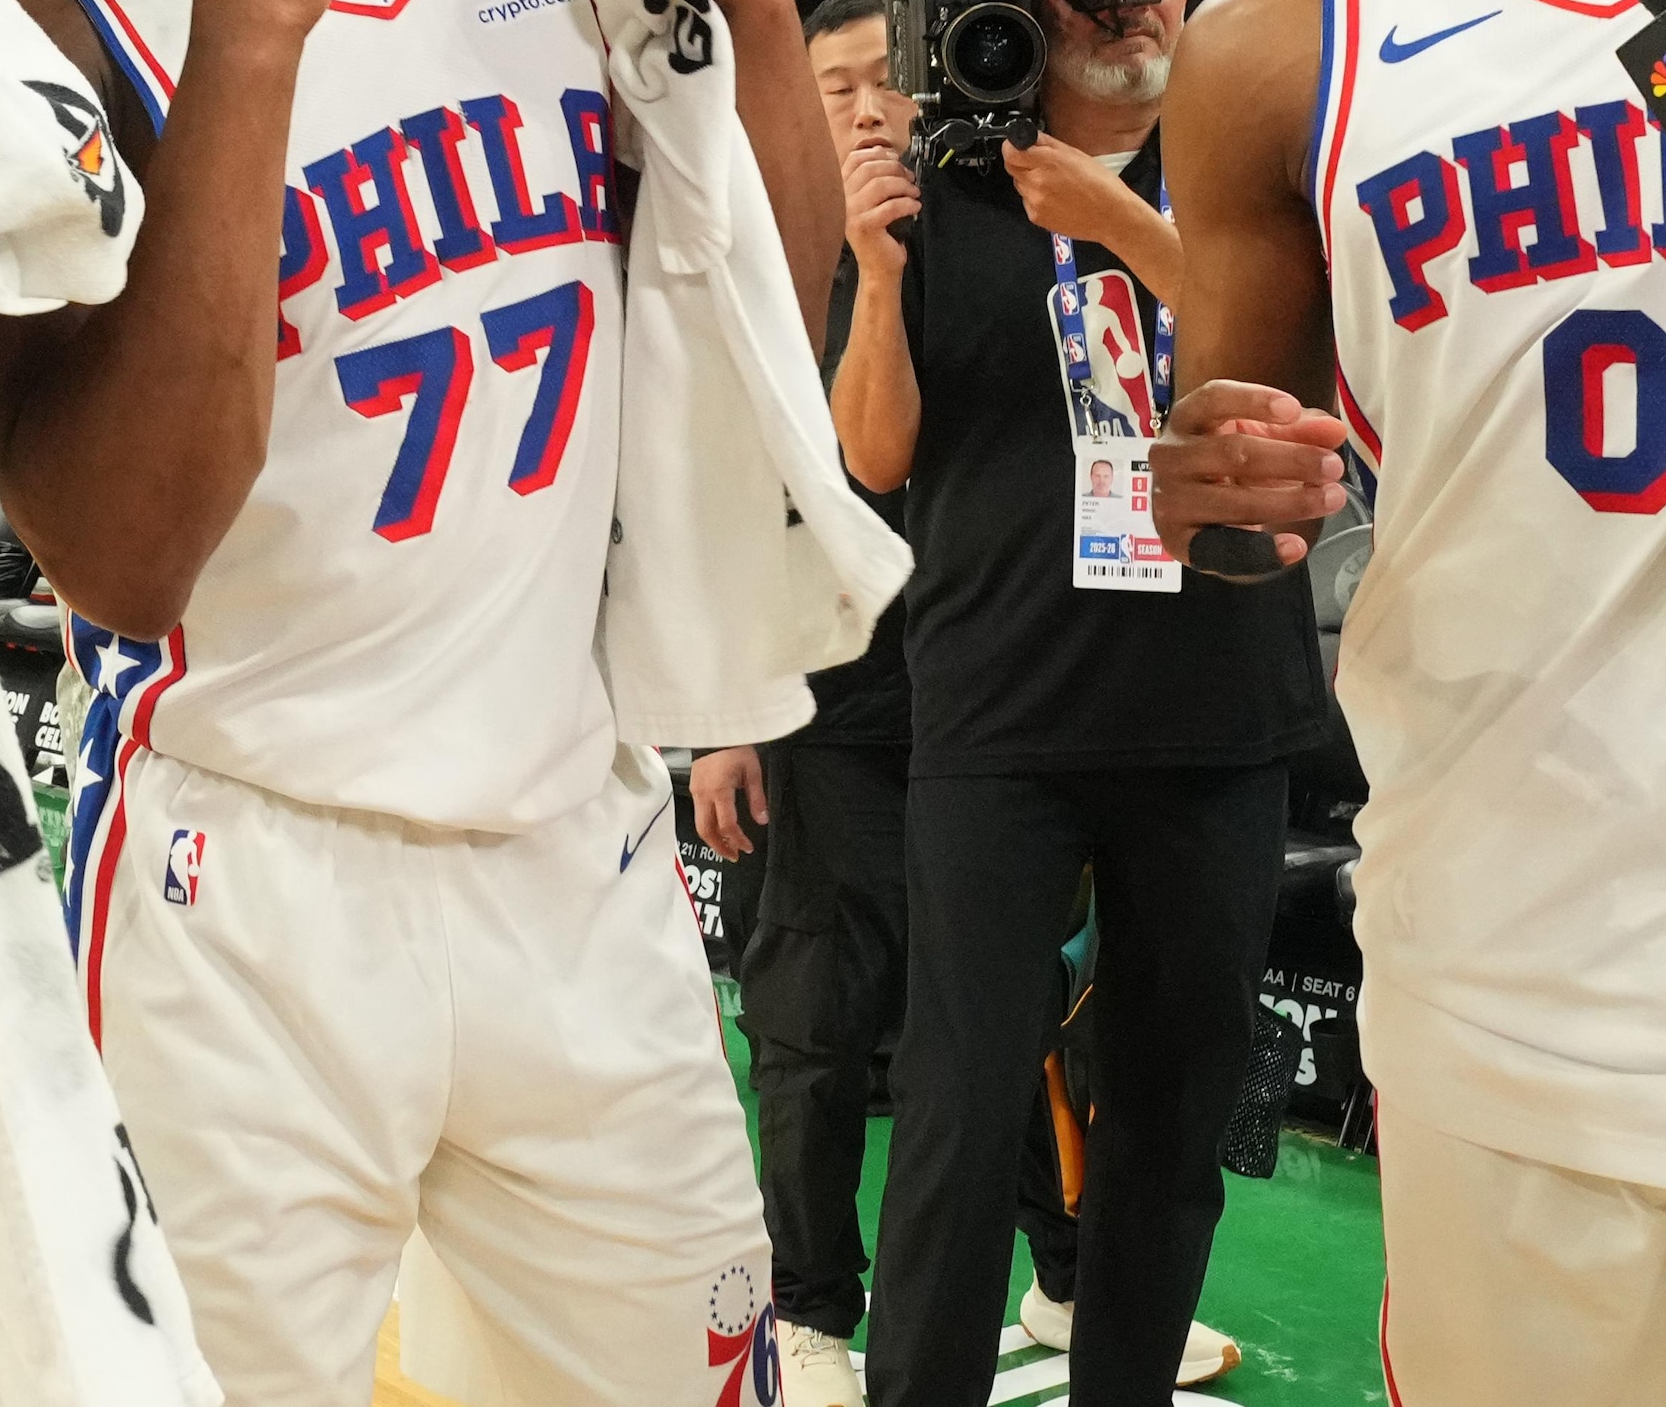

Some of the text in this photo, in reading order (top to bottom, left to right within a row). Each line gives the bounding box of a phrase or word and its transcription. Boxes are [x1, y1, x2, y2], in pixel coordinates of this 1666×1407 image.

[334, 279, 595, 544] 77
[1137, 543, 1163, 556] SEASON
[167, 885, 185, 902] NBA
[1263, 967, 1285, 986] AA
[1302, 976, 1343, 998] SEAT
[1345, 985, 1356, 1002] 6
